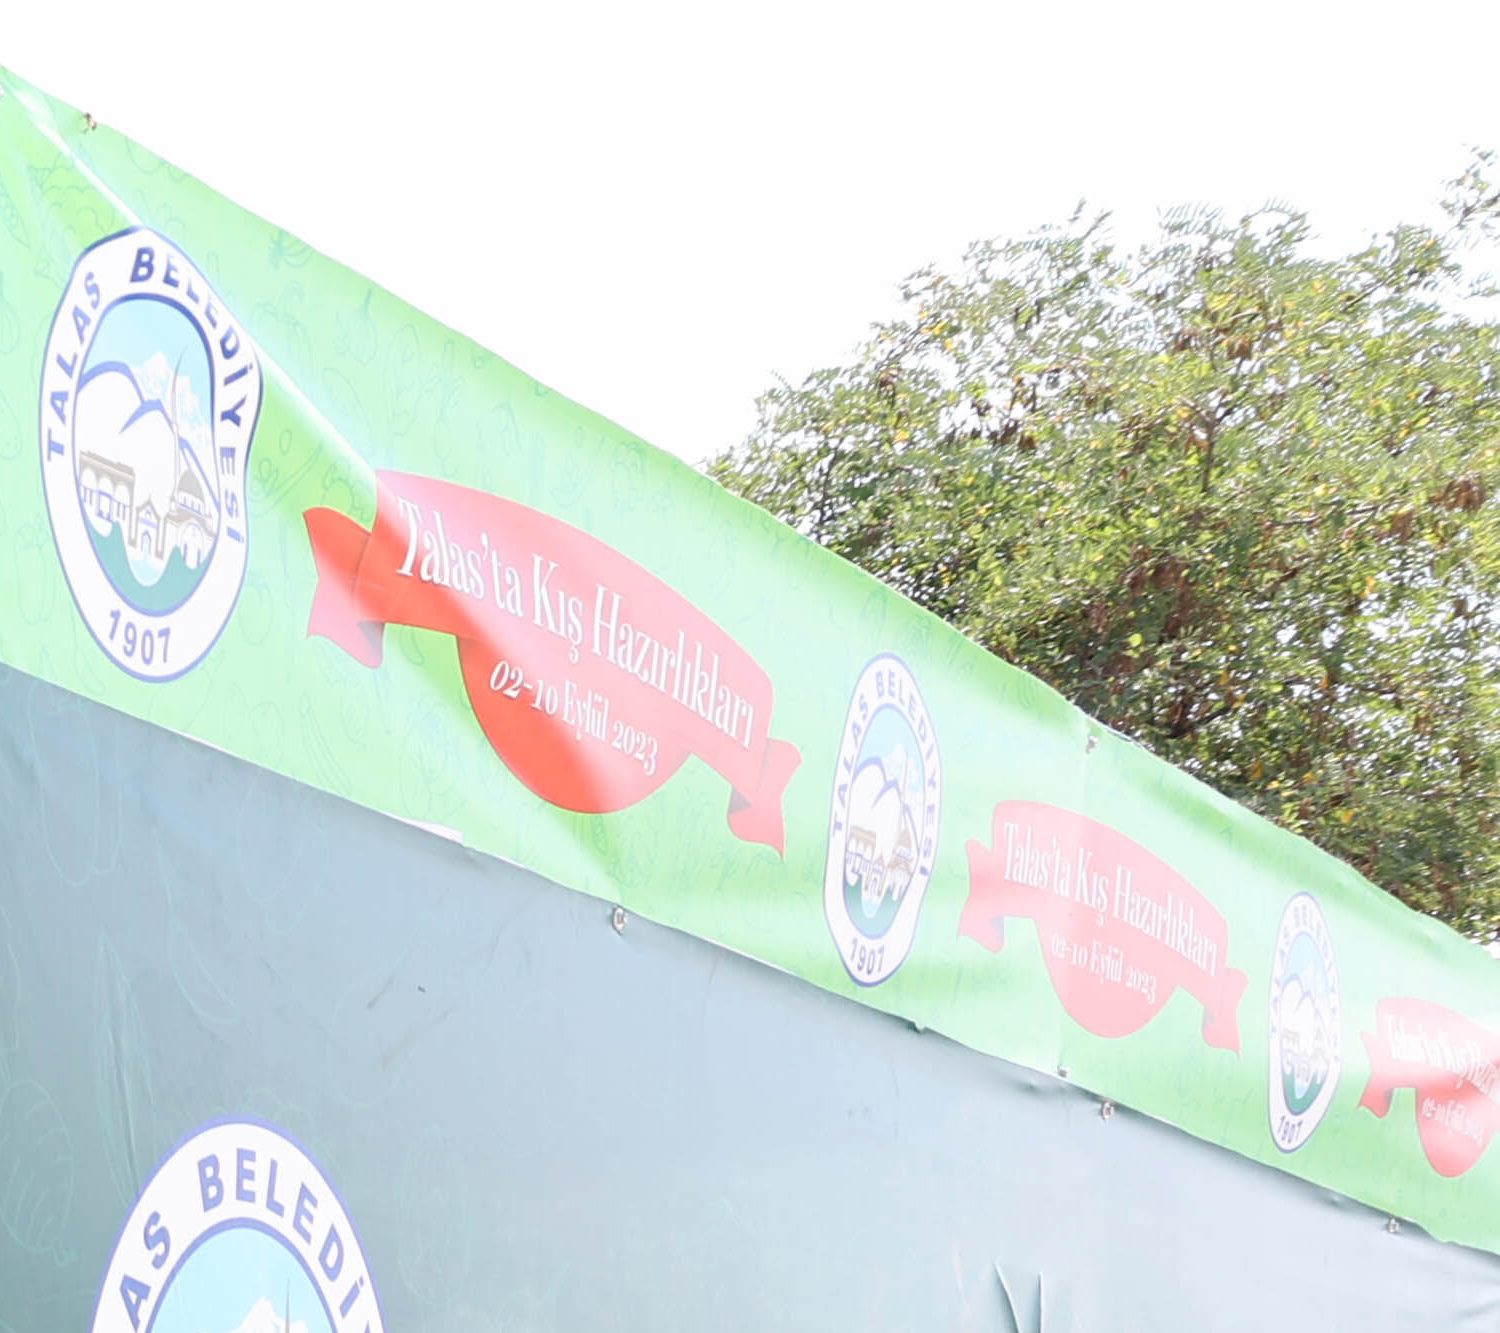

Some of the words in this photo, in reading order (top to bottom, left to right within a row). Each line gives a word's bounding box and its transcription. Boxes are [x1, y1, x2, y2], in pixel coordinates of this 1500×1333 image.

[47, 271, 101, 462] TALAS
[129, 246, 259, 545] BELEDİYESİ
[108, 610, 171, 665] 1907
[396, 497, 524, 620] Talas'ta
[524, 553, 586, 664] Kış
[592, 585, 755, 750] Hazırlıkları
[489, 659, 559, 719] 02-10
[563, 680, 609, 749] Eylül
[612, 717, 660, 776] 2023
[831, 688, 871, 842] TALAS
[848, 936, 887, 974] 1907
[1003, 819, 1072, 907] Talas'ta
[1075, 844, 1109, 929] Kış
[1113, 861, 1220, 975] Hazırlıkları
[1051, 931, 1088, 971] 02-10
[1090, 936, 1124, 984] Eylül
[1126, 964, 1159, 1004] 2023
